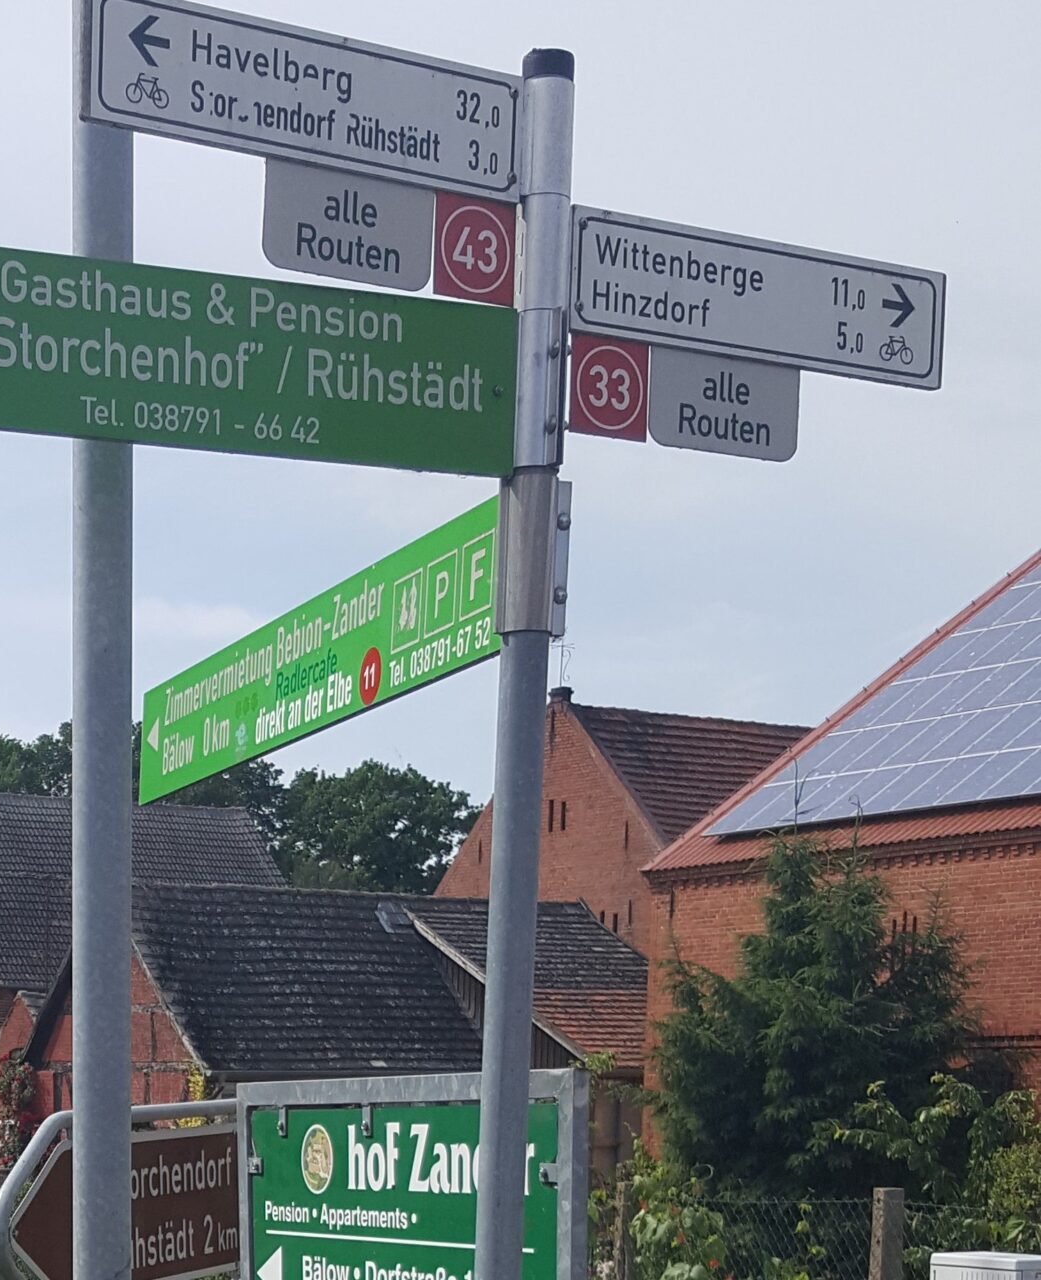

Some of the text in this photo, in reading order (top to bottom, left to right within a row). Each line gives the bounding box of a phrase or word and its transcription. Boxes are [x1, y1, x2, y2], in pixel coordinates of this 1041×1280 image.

[191, 29, 500, 128] Havelberg 32,0
[191, 80, 498, 176] Sorendorf Rühstädt 3,0
[324, 190, 377, 228] alle
[296, 222, 400, 274] Routen
[452, 226, 497, 274] 43
[596, 233, 865, 312] Wittenberge 11,0
[1, 260, 402, 343] Gasthaus & Pension
[592, 280, 864, 355] Hinzdorf 5,0
[276, 345, 292, 394] /
[307, 348, 483, 412] Rühstädt
[588, 364, 631, 411] 33
[703, 371, 750, 406] alle
[80, 395, 124, 427] Tel.
[134, 400, 220, 436] 038791
[254, 412, 282, 441] 66
[290, 415, 319, 444] 42
[678, 402, 771, 447] Routen
[433, 571, 448, 618] P
[469, 548, 486, 601] F
[164, 579, 385, 727] Zimmervermietung Bebion-Zander
[364, 663, 375, 690] 11
[389, 617, 491, 688] Tel. 038791-67 52
[255, 670, 353, 744] direkt an der Elbe
[162, 731, 195, 775] Bälow
[130, 1147, 232, 1200] orchendorf
[409, 1123, 535, 1196] Zanr
[265, 1200, 408, 1230] Pension Appartements
[131, 1214, 238, 1270] hstädt 2 km
